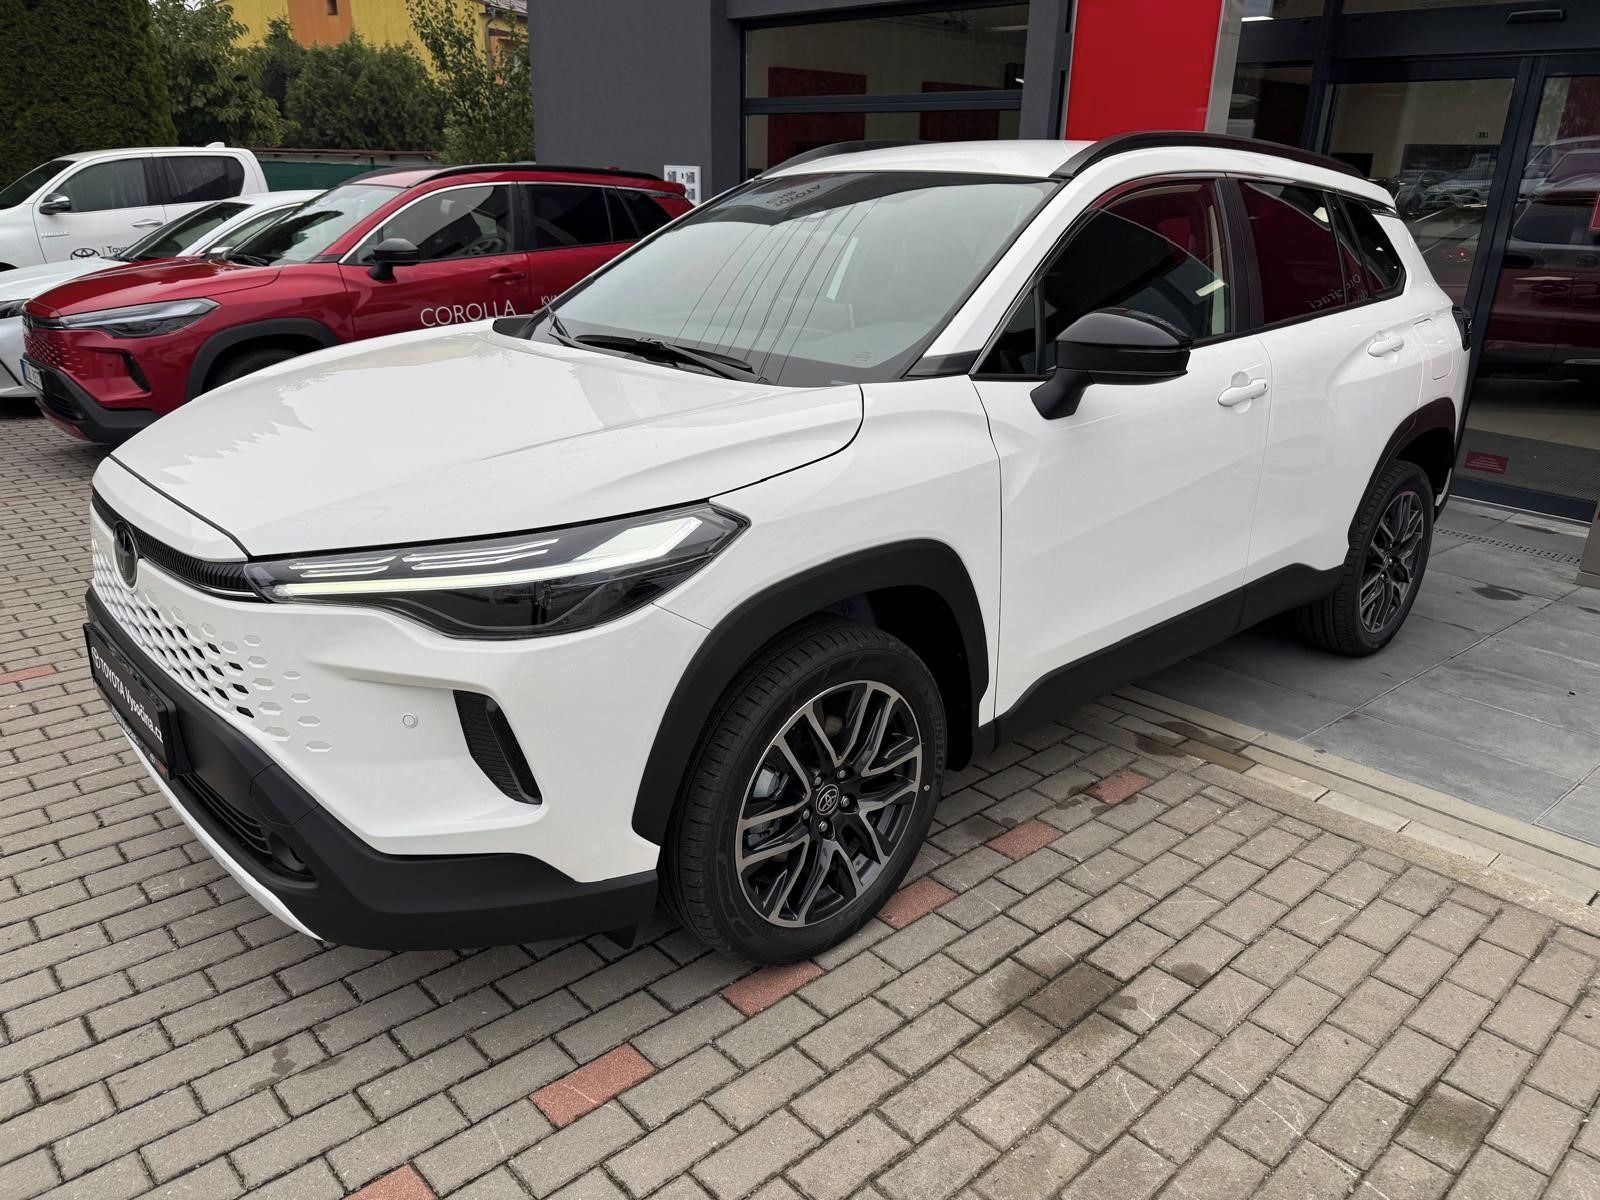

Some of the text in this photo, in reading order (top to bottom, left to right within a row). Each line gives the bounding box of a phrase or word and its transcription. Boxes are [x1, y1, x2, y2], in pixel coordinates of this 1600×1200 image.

[420, 299, 517, 327] COROLLA
[100, 658, 126, 700] TOYOTA
[124, 686, 164, 744] Vysočina.cz
